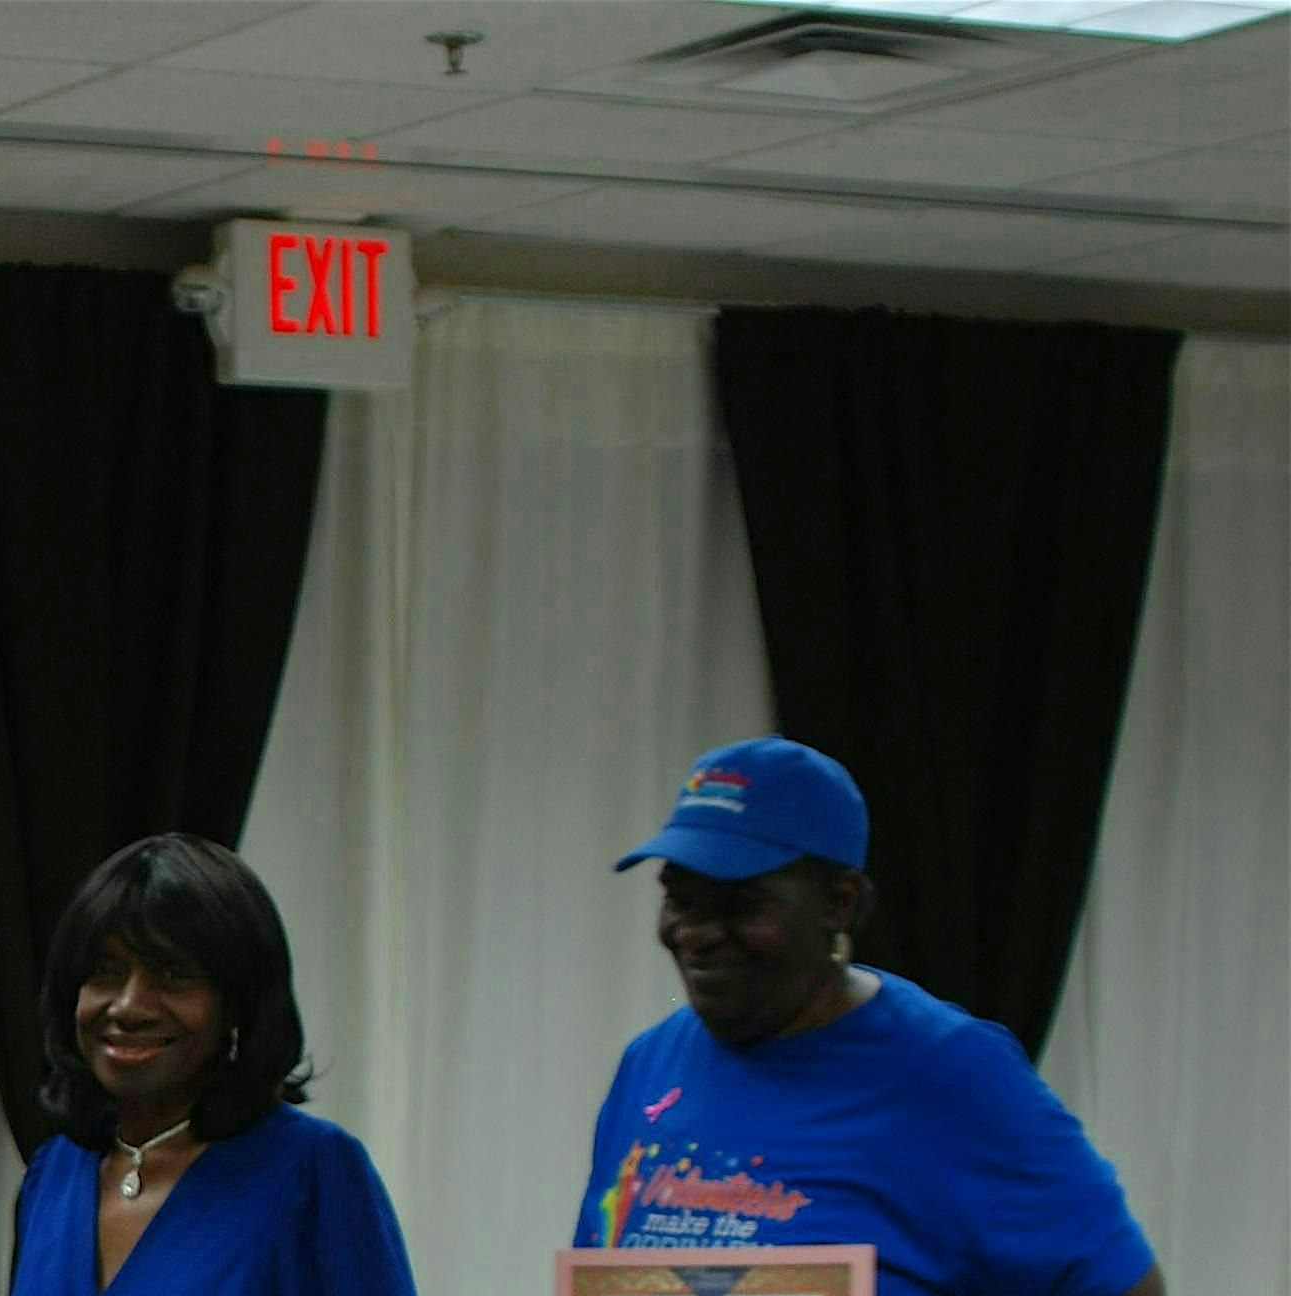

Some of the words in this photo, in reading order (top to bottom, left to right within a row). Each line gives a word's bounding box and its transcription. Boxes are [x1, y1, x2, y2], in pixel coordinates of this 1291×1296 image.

[269, 233, 389, 339] EXIT
[641, 1209, 710, 1235] make
[713, 1210, 759, 1238] the
